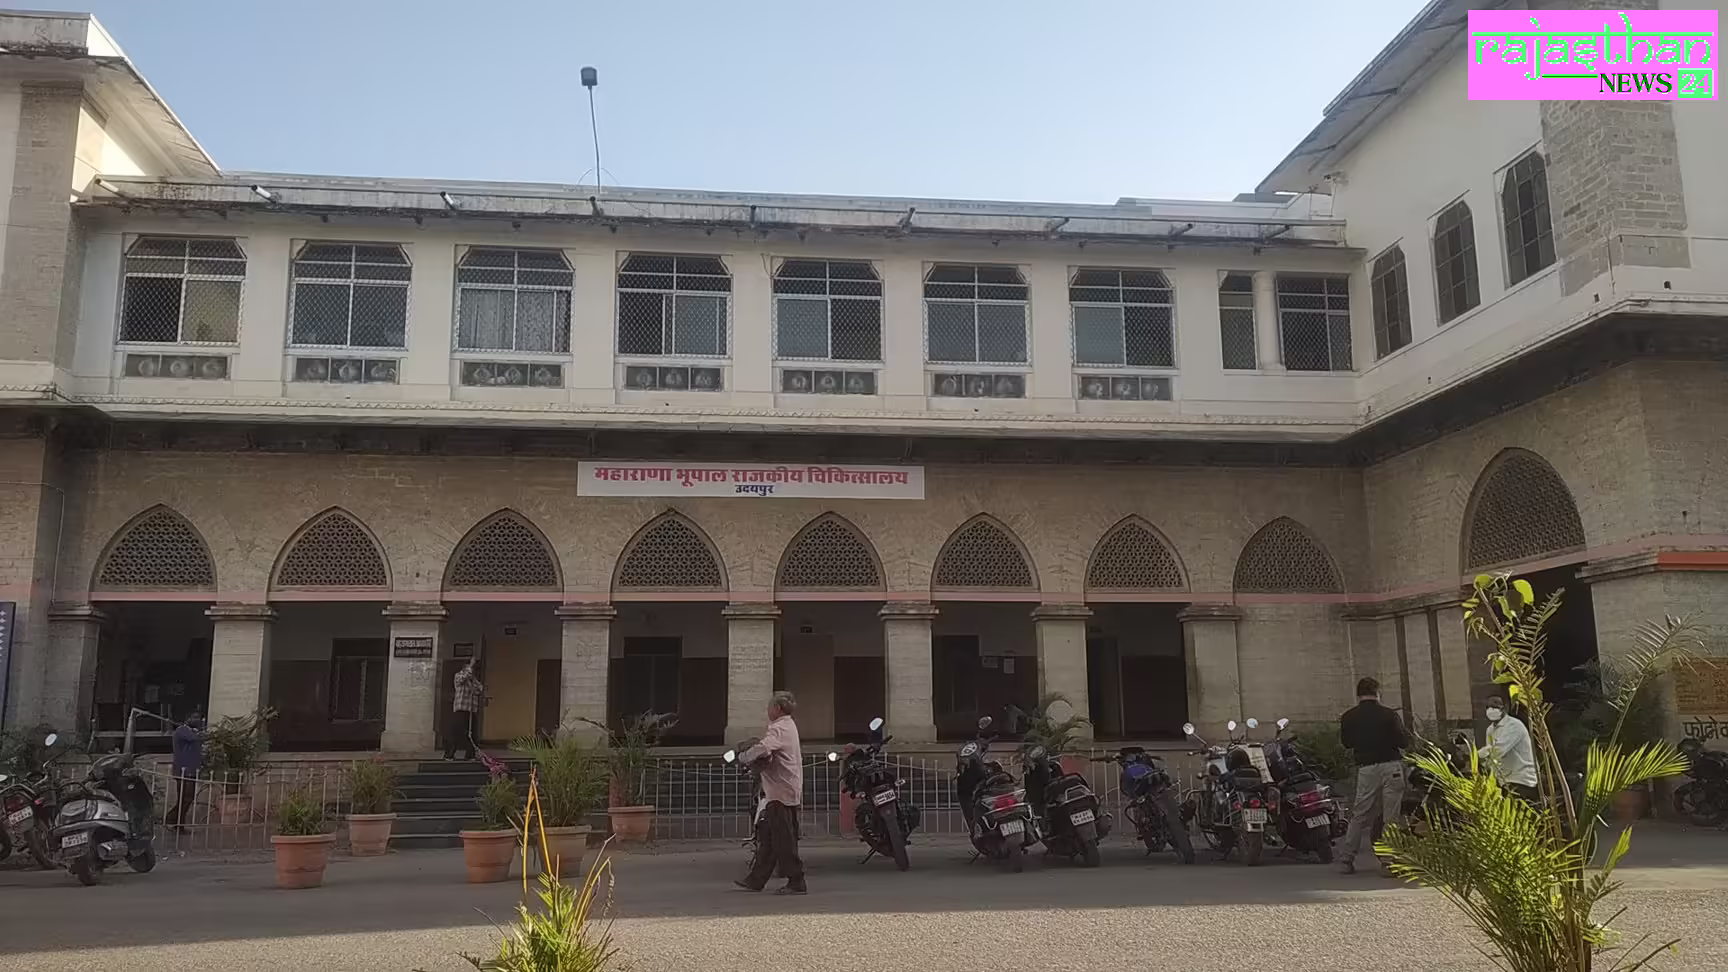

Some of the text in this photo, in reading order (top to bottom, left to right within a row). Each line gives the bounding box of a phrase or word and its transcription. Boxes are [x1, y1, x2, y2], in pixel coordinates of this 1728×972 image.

[594, 466, 909, 488] महाराणा भूपाल राजकीय चिकित्सालय
[734, 484, 775, 496] उदयपुर
